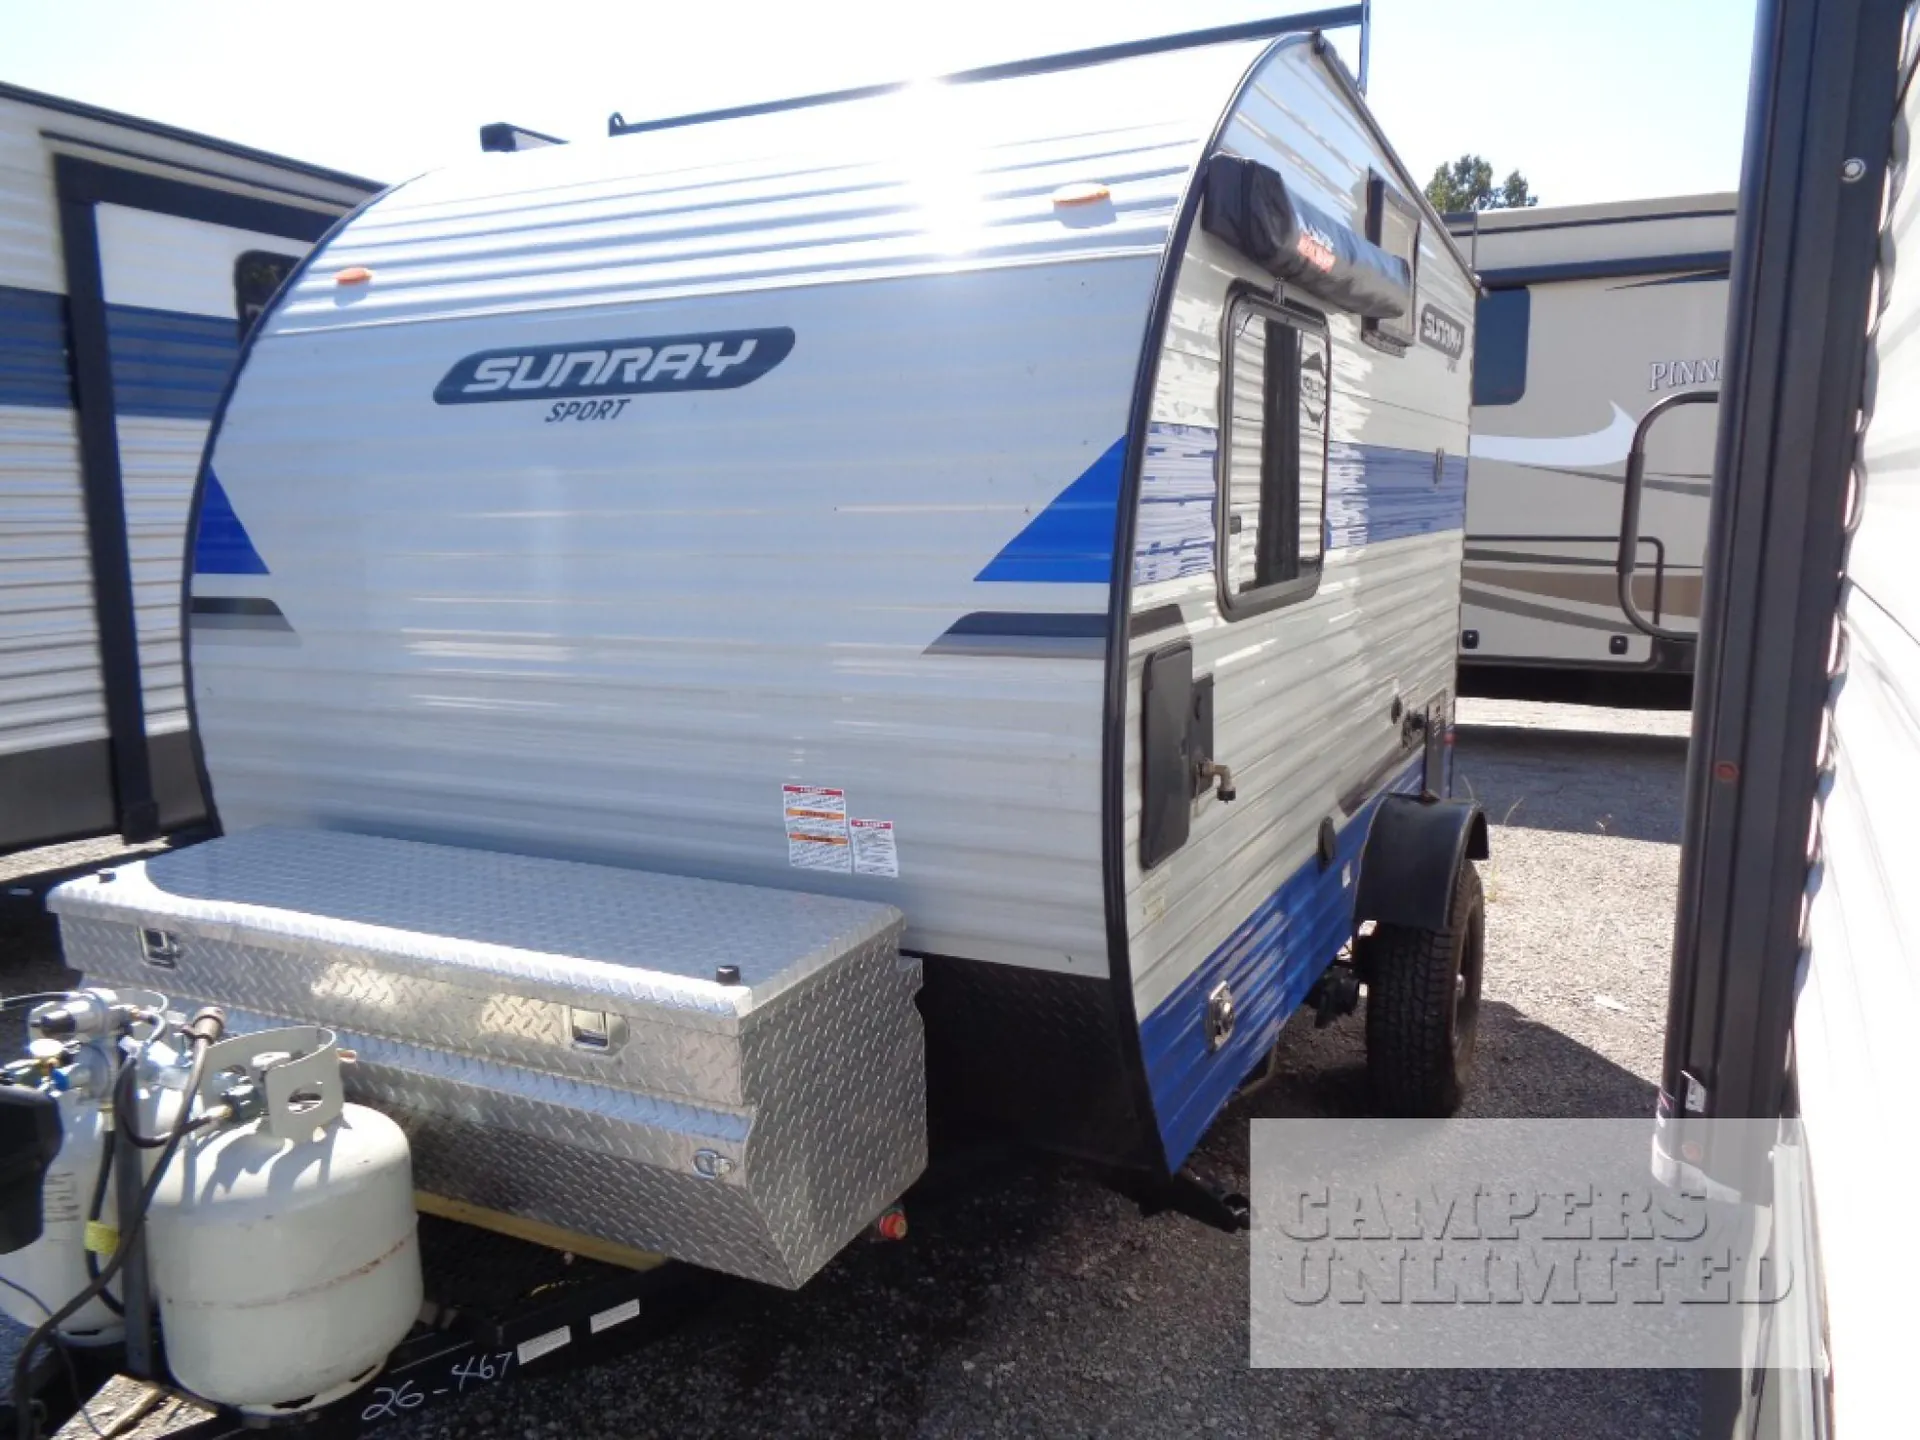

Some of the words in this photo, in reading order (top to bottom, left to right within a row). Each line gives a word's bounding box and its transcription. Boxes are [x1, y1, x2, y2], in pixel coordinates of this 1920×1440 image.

[462, 338, 758, 394] SUNRAY
[1648, 358, 1722, 392] PINN
[544, 398, 632, 423] SPORT
